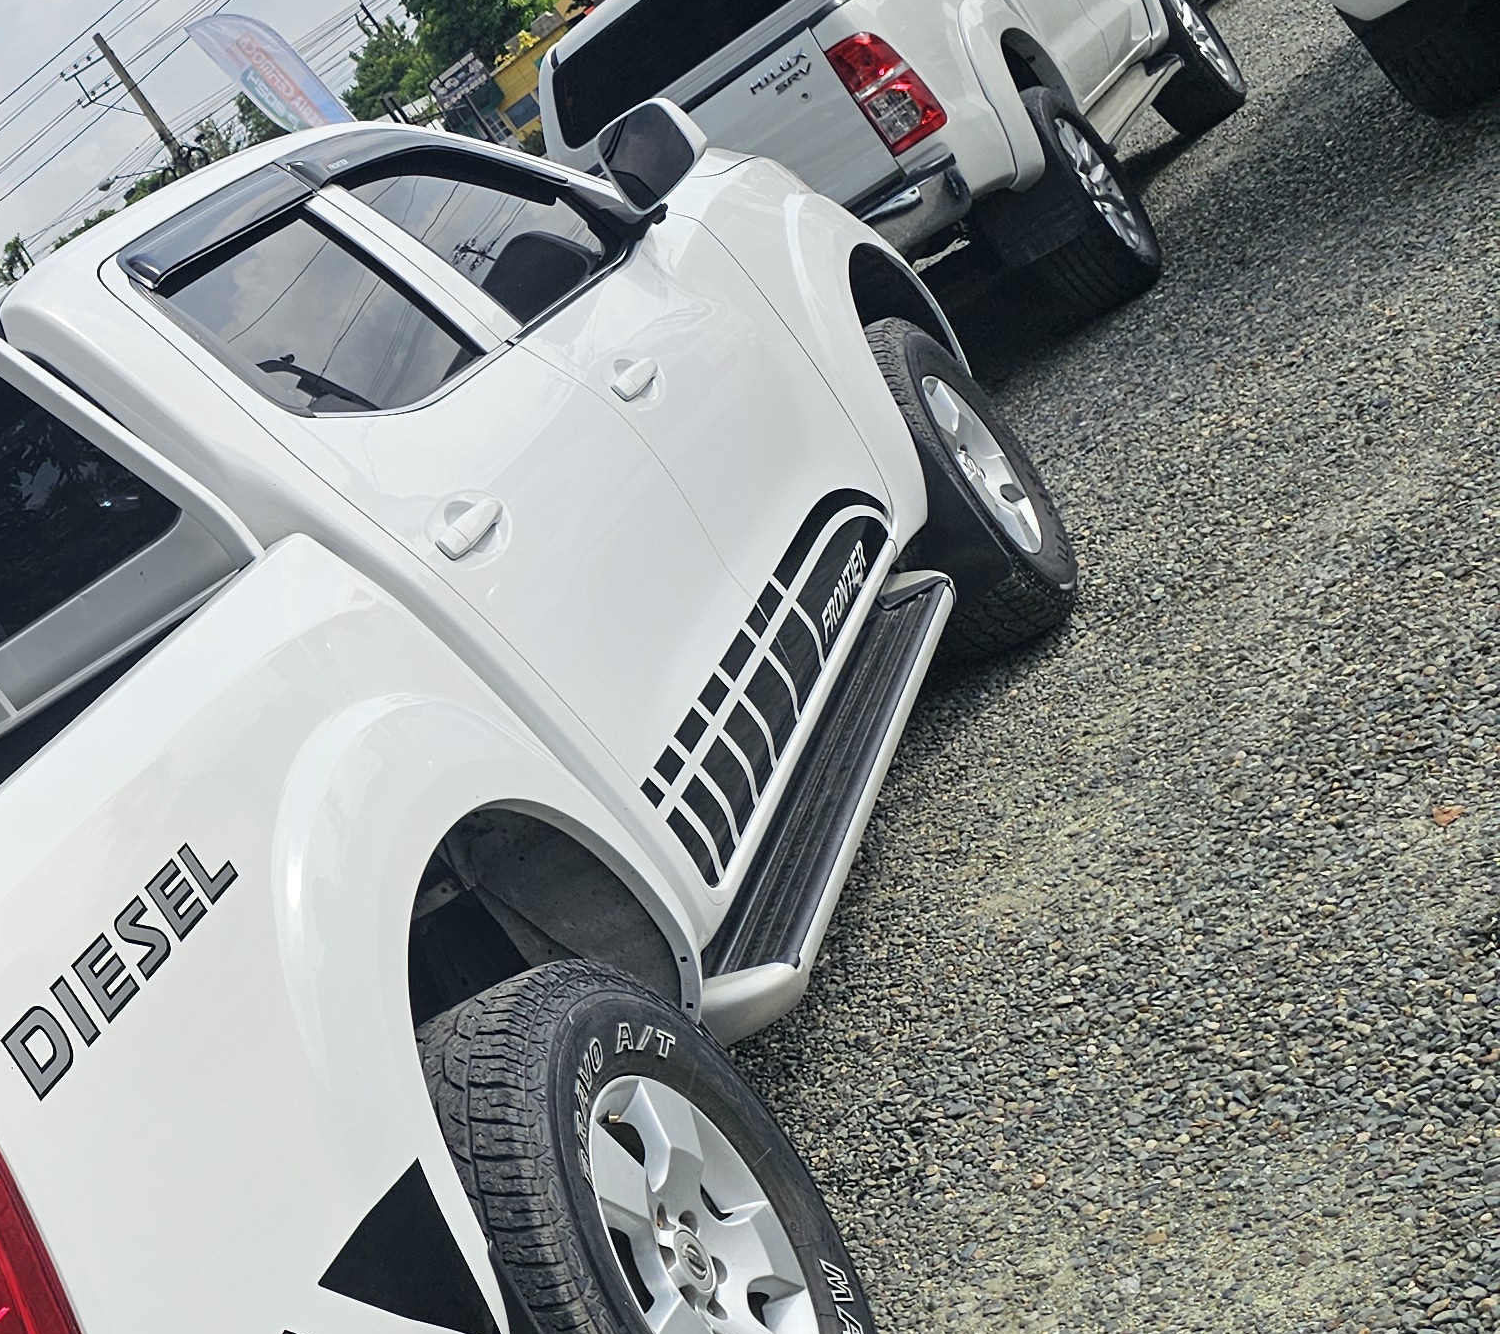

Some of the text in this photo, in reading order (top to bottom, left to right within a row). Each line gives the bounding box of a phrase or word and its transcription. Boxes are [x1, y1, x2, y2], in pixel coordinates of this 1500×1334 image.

[749, 48, 808, 95] HILUX
[775, 62, 812, 95] SRV
[821, 540, 867, 644] FRONTIER
[0, 842, 239, 1101] DIESEL
[615, 1021, 676, 1059] A/T
